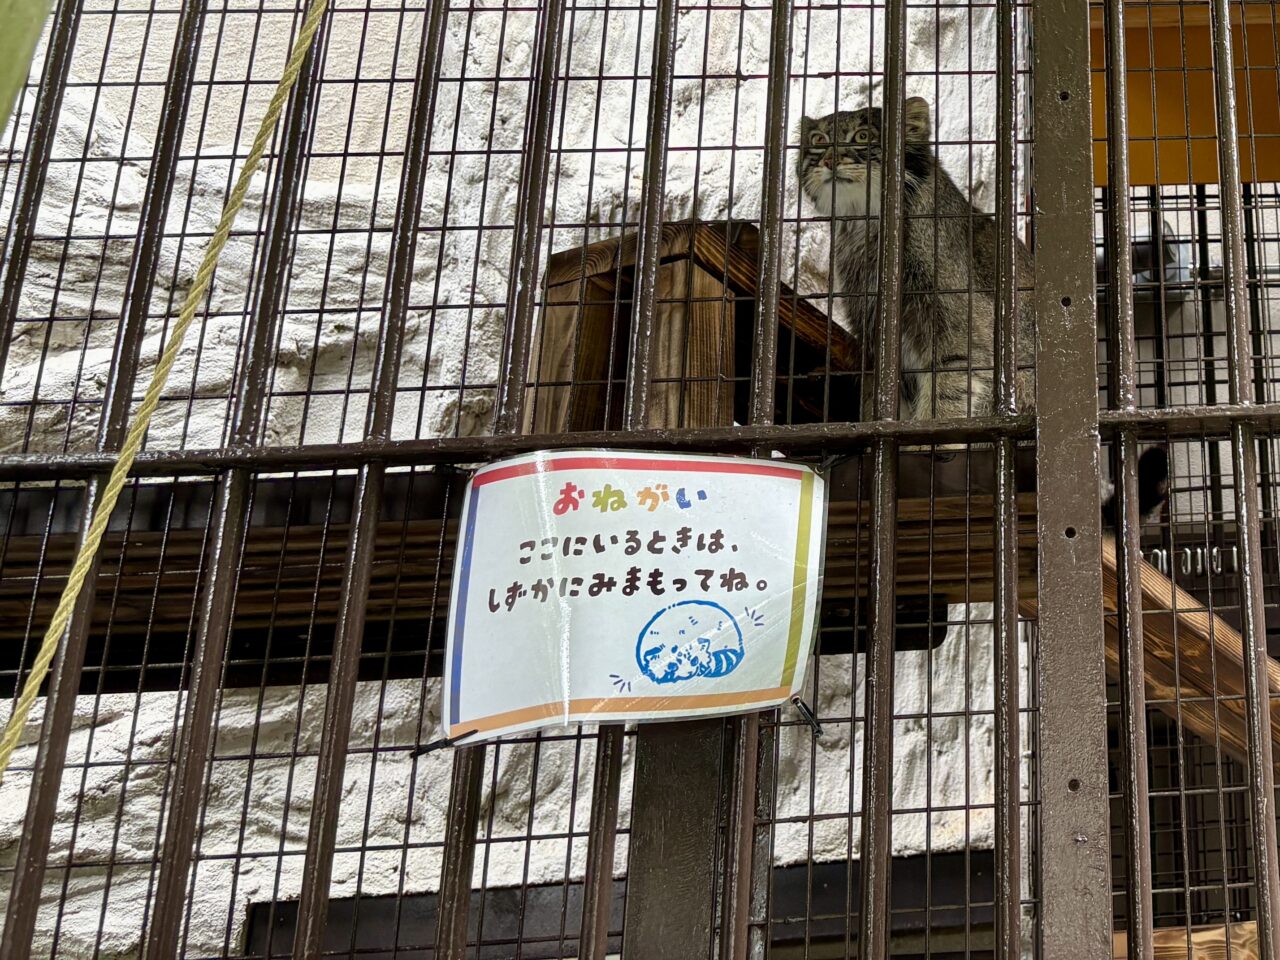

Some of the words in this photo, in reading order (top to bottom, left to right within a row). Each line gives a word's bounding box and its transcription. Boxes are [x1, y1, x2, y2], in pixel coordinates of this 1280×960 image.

[553, 481, 707, 515] おねがい
[519, 527, 738, 564] ここにいるときは、
[488, 566, 768, 613] しずかにみまもってね。
